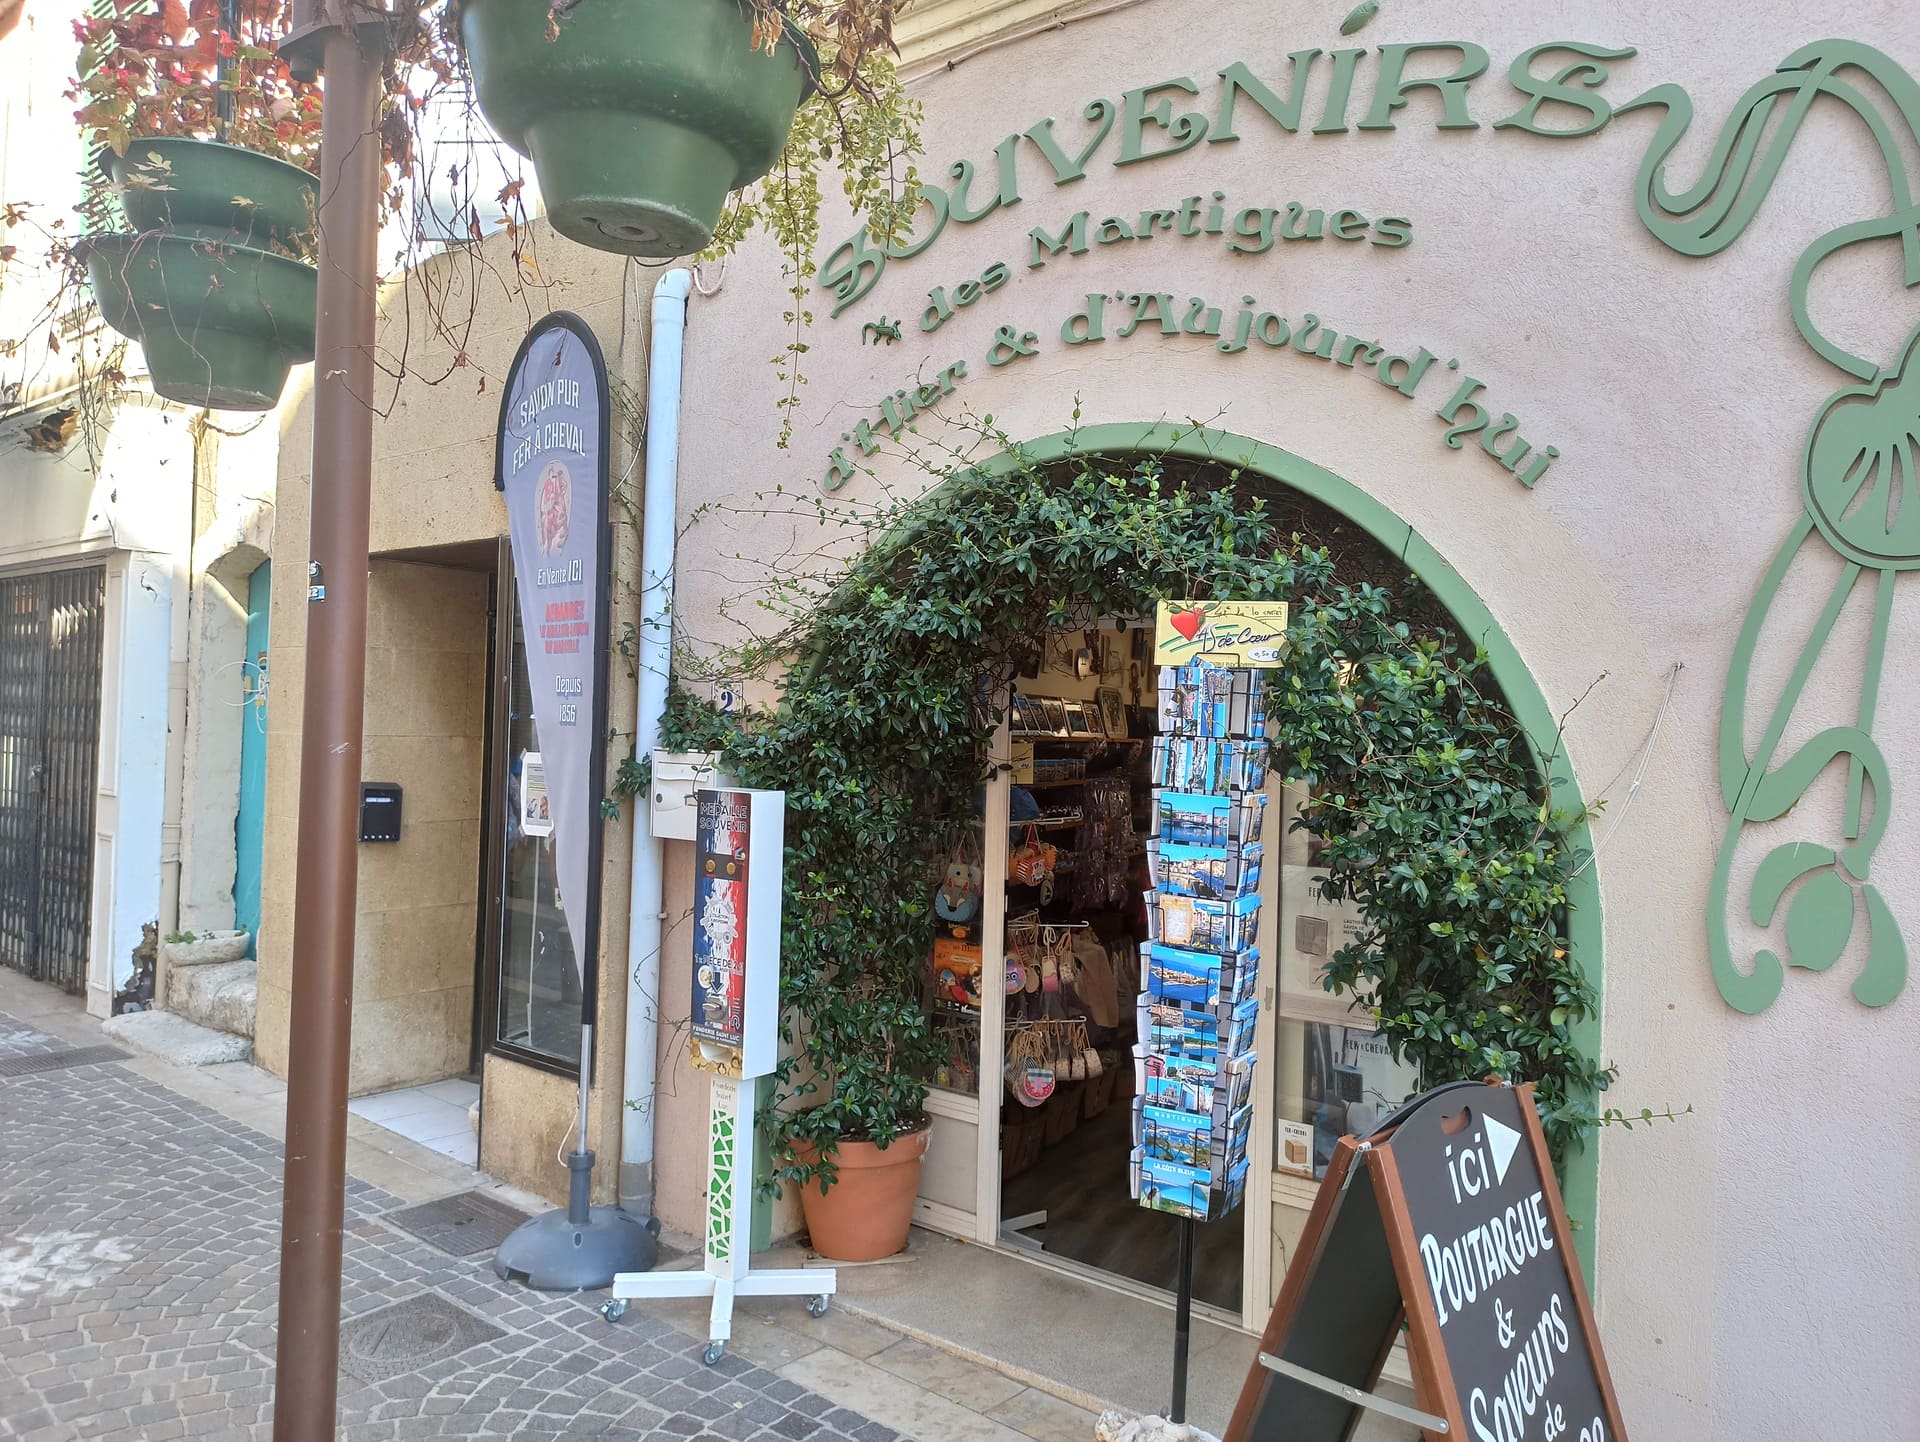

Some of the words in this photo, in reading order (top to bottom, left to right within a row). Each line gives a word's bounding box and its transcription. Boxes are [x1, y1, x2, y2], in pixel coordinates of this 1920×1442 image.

[818, 40, 1637, 318] SOUVENIRS
[919, 261, 1012, 332] des
[1026, 191, 1414, 270] Martigues
[520, 380, 555, 428] SAVON
[557, 378, 579, 409] PUR
[823, 359, 968, 492] d'Hier
[985, 323, 1040, 368] &
[1060, 291, 1560, 491] d'Aujourd'hui
[512, 436, 531, 475] FER
[544, 422, 586, 457] CHEVAL
[537, 568, 546, 585] En
[546, 567, 567, 585] Vente
[568, 559, 582, 583] ICI
[1218, 632, 1235, 649] de
[555, 675, 582, 697] Depuis
[720, 691, 734, 715] 2
[559, 704, 576, 722] 1856
[699, 817, 747, 833] SOUVENIR
[729, 1033, 740, 1042] LUC
[1365, 1042, 1393, 1057] CHEVA
[1445, 1132, 1490, 1204] ici
[1420, 1191, 1554, 1328] POUTARGUE
[1494, 1297, 1516, 1349] &
[1469, 1293, 1570, 1442] Saveurs
[1544, 1399, 1567, 1442] de
